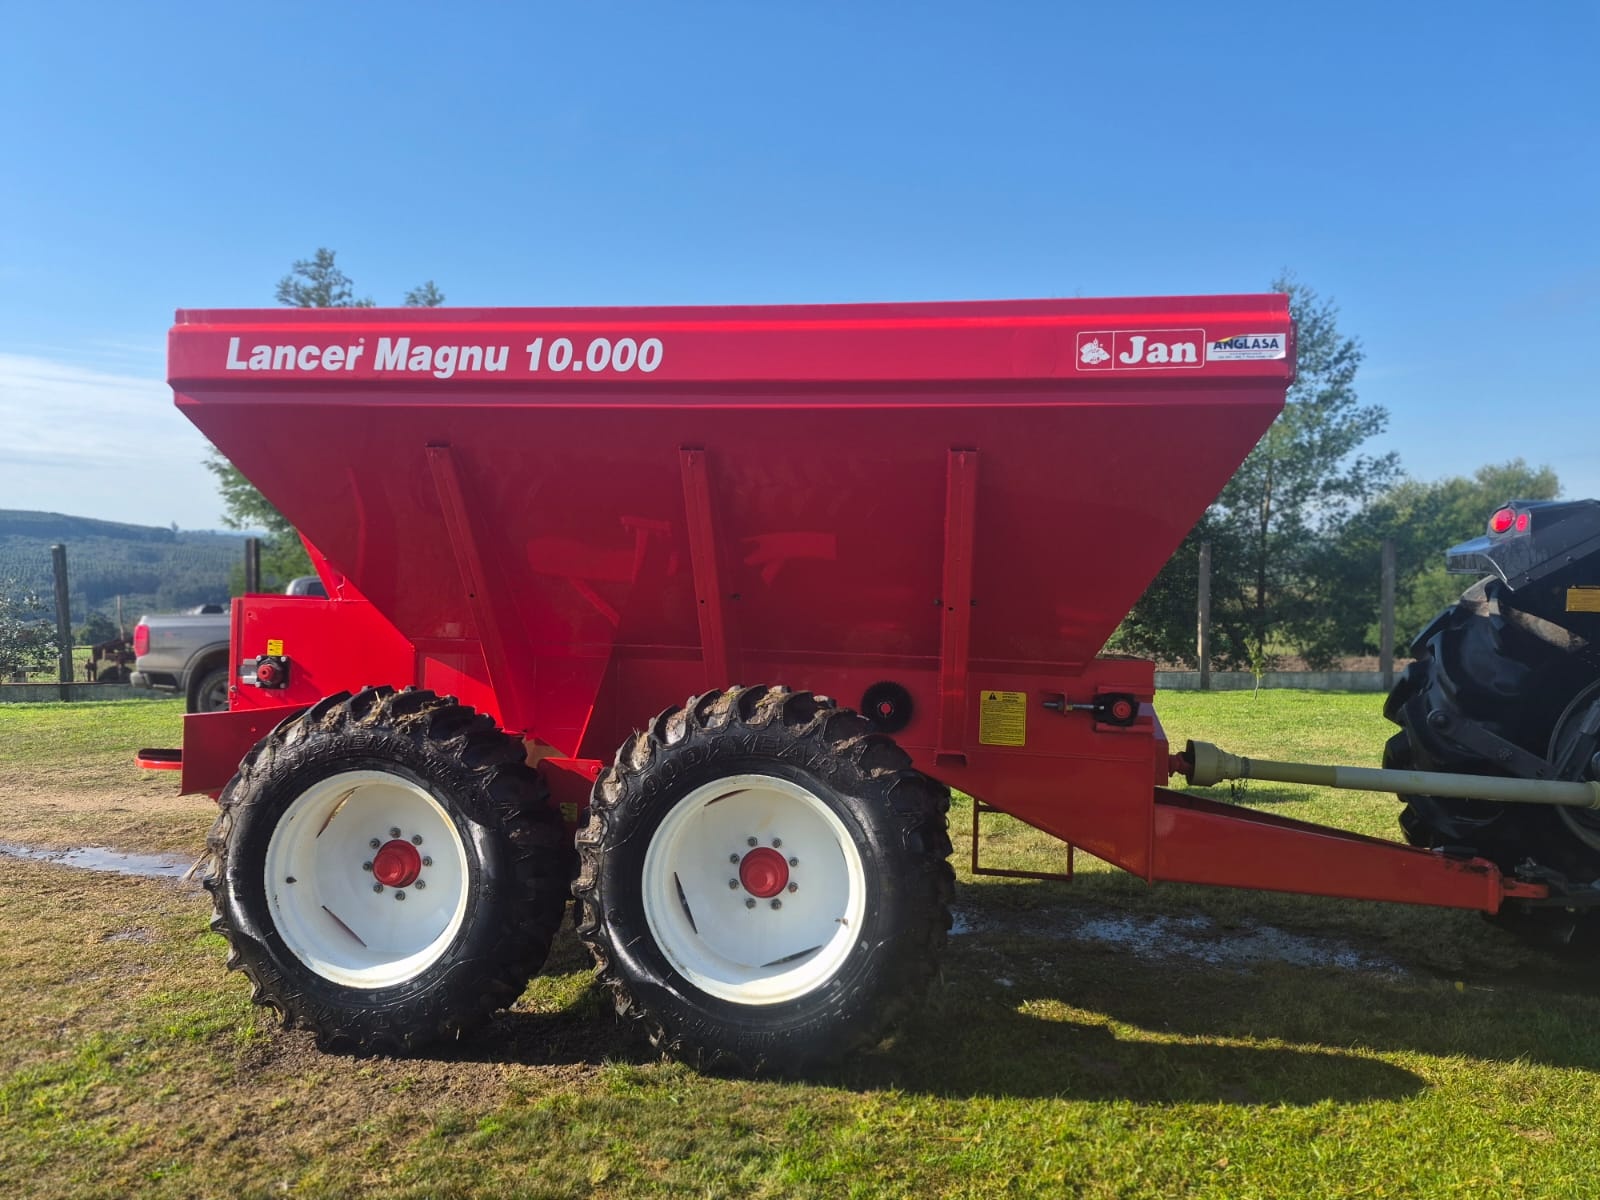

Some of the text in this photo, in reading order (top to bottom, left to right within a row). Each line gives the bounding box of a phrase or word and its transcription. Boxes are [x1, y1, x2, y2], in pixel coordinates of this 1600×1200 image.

[225, 337, 664, 378] Lancer Magnu 10.000
[1119, 336, 1198, 364] Jan
[1213, 337, 1279, 351] ANGLASA
[630, 733, 839, 816] GOODYEAR
